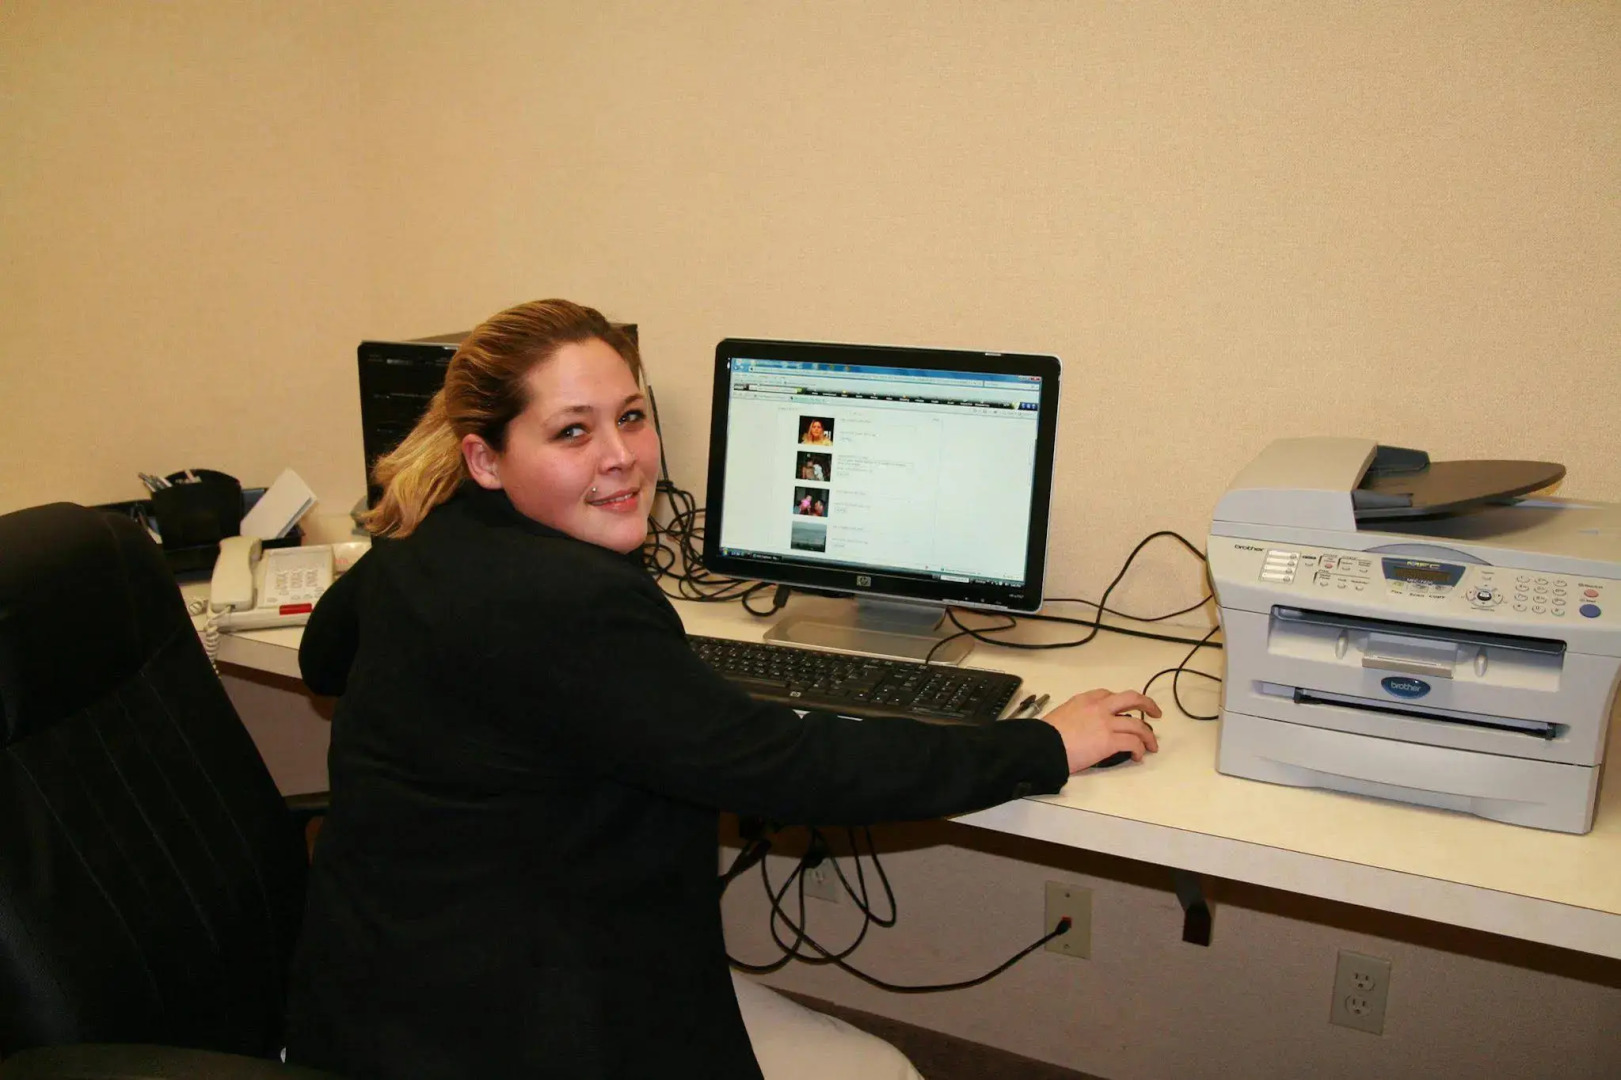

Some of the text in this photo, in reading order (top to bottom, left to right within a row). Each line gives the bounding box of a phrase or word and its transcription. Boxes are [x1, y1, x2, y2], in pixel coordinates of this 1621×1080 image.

[1234, 543, 1265, 553] brother
[1406, 560, 1441, 569] MFC
[1390, 681, 1421, 692] brother
